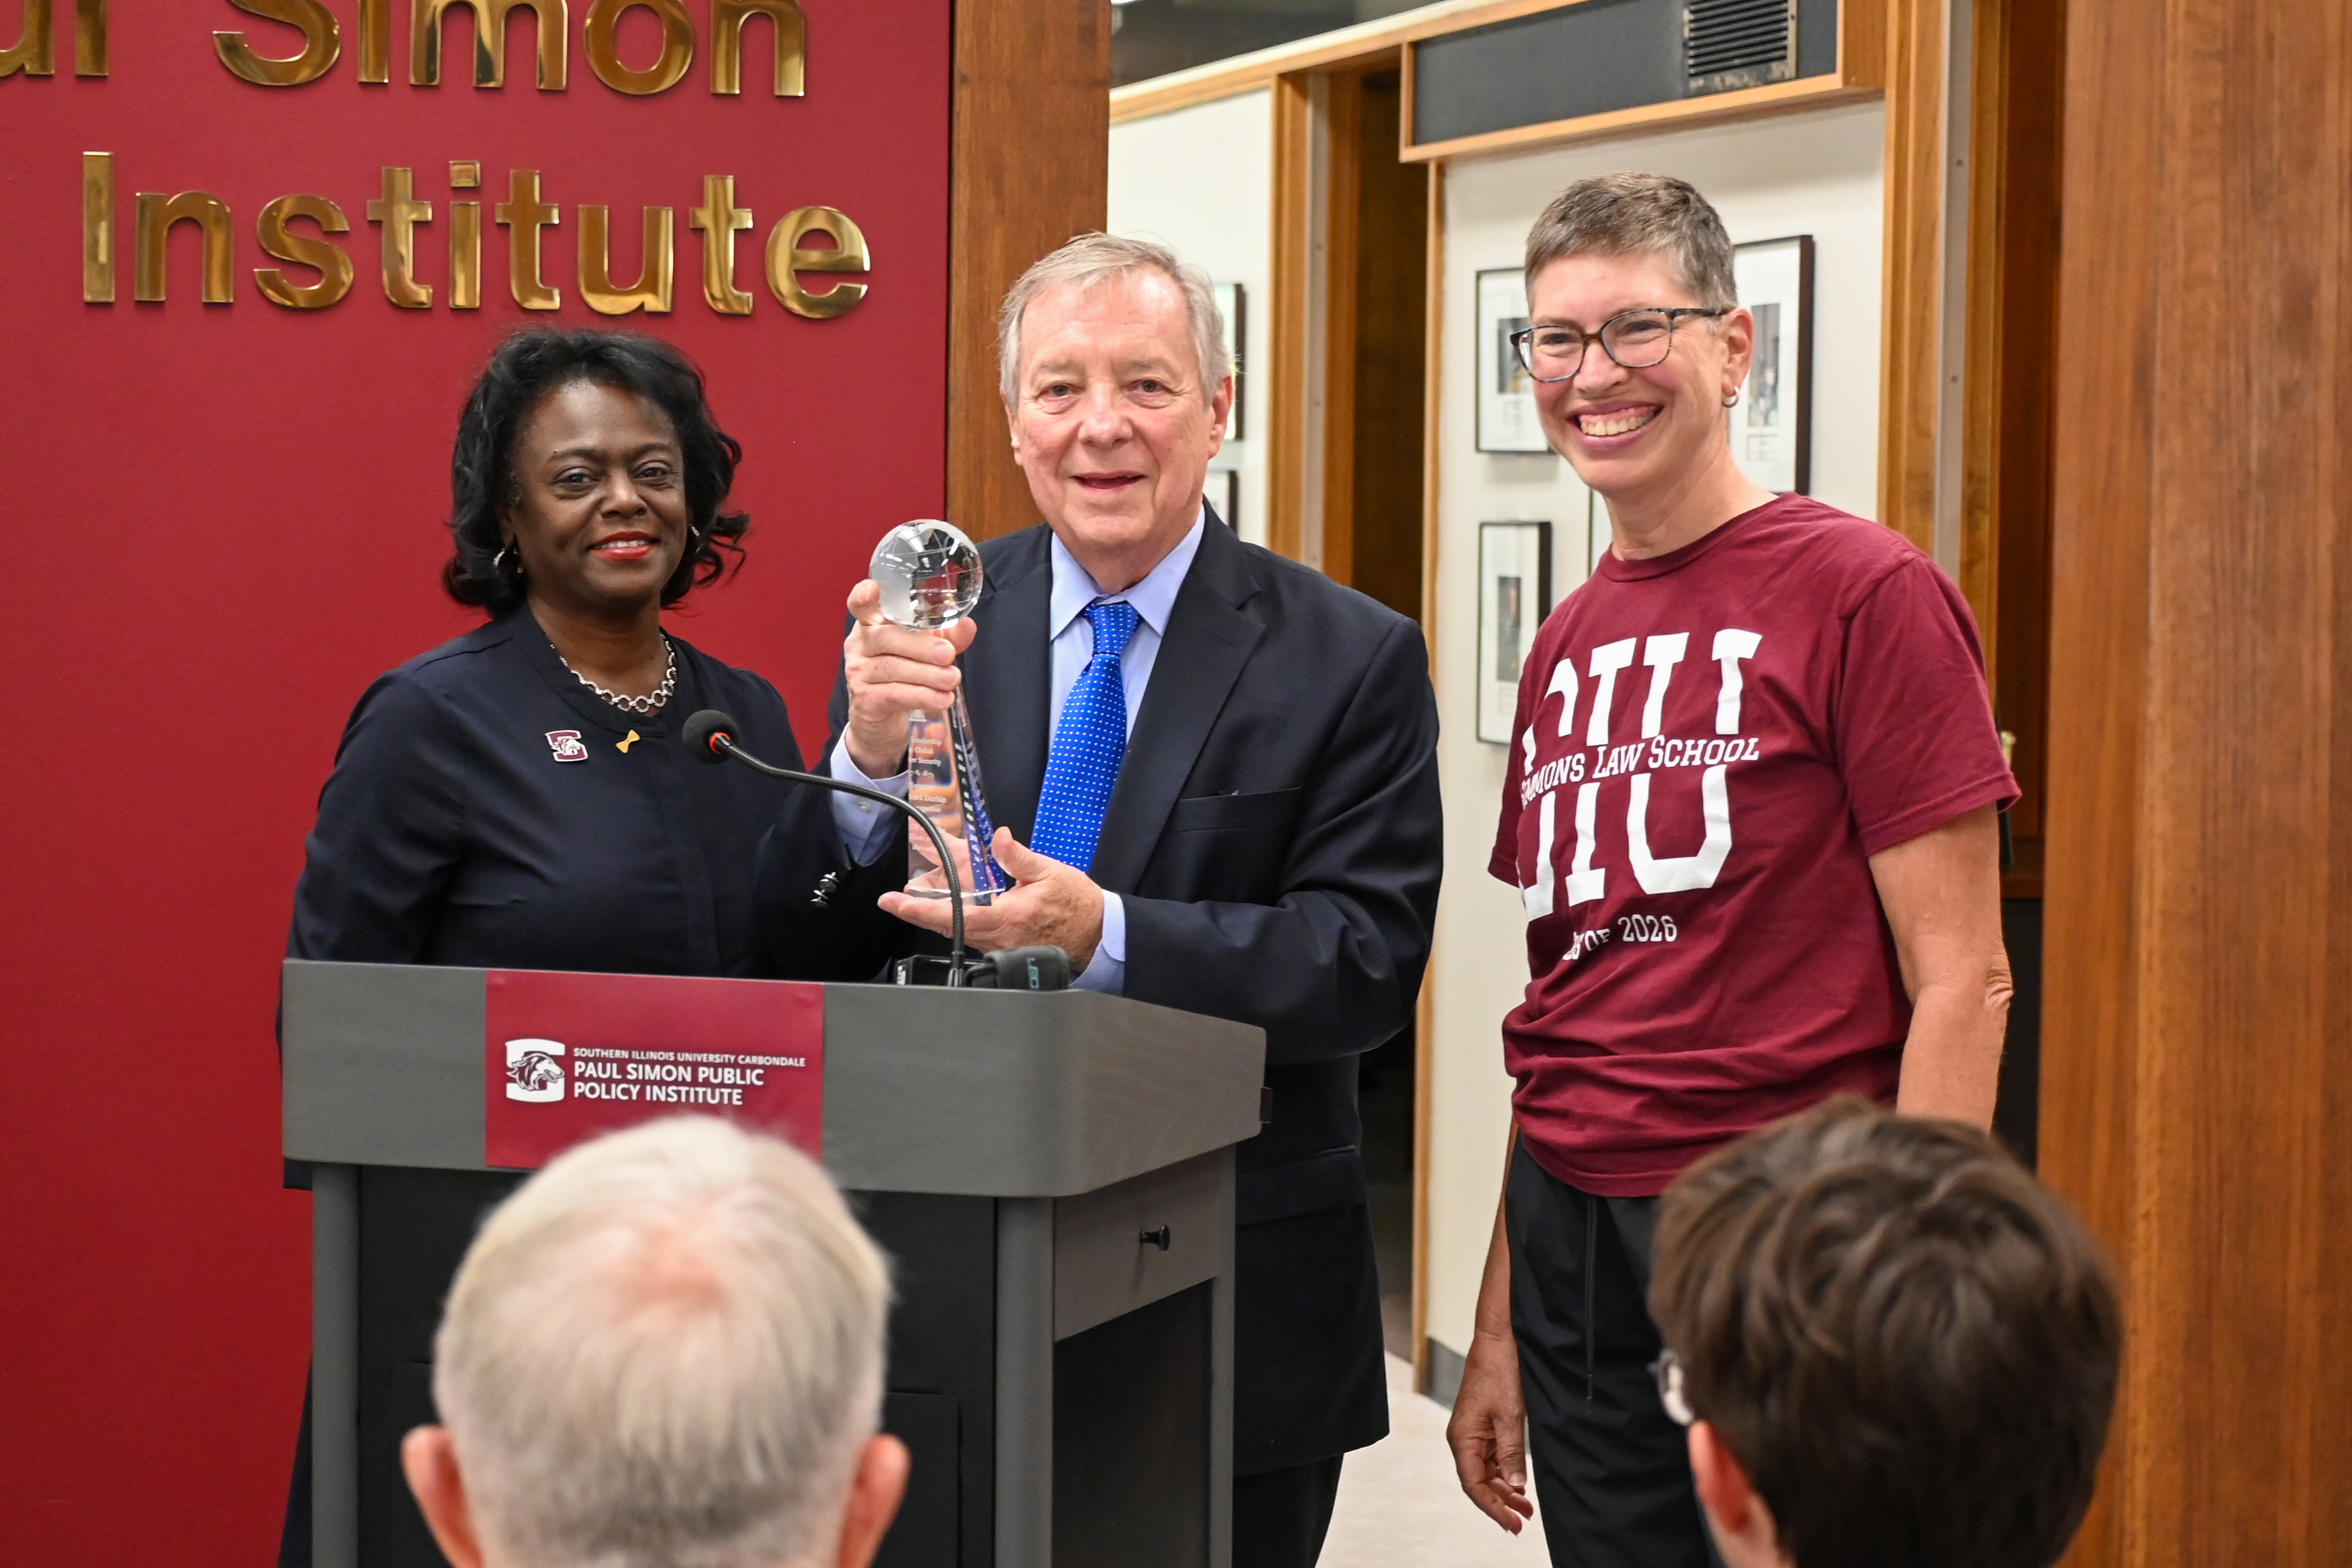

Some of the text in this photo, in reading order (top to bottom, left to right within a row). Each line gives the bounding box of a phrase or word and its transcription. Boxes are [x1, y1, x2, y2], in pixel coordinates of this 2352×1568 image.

[212, 0, 805, 96] Simon
[82, 151, 870, 319] Institute
[1592, 742, 1646, 779] LAW
[1648, 734, 1760, 769] SCHOOL
[1618, 914, 1677, 942] 2026
[573, 1048, 806, 1067] SOUTHERN ILLINOIS UNIVERSITY CARBONDALE
[574, 1061, 764, 1086] PAUL SIMON PUBLIC
[574, 1082, 743, 1105] POLICY INSTITUTE
